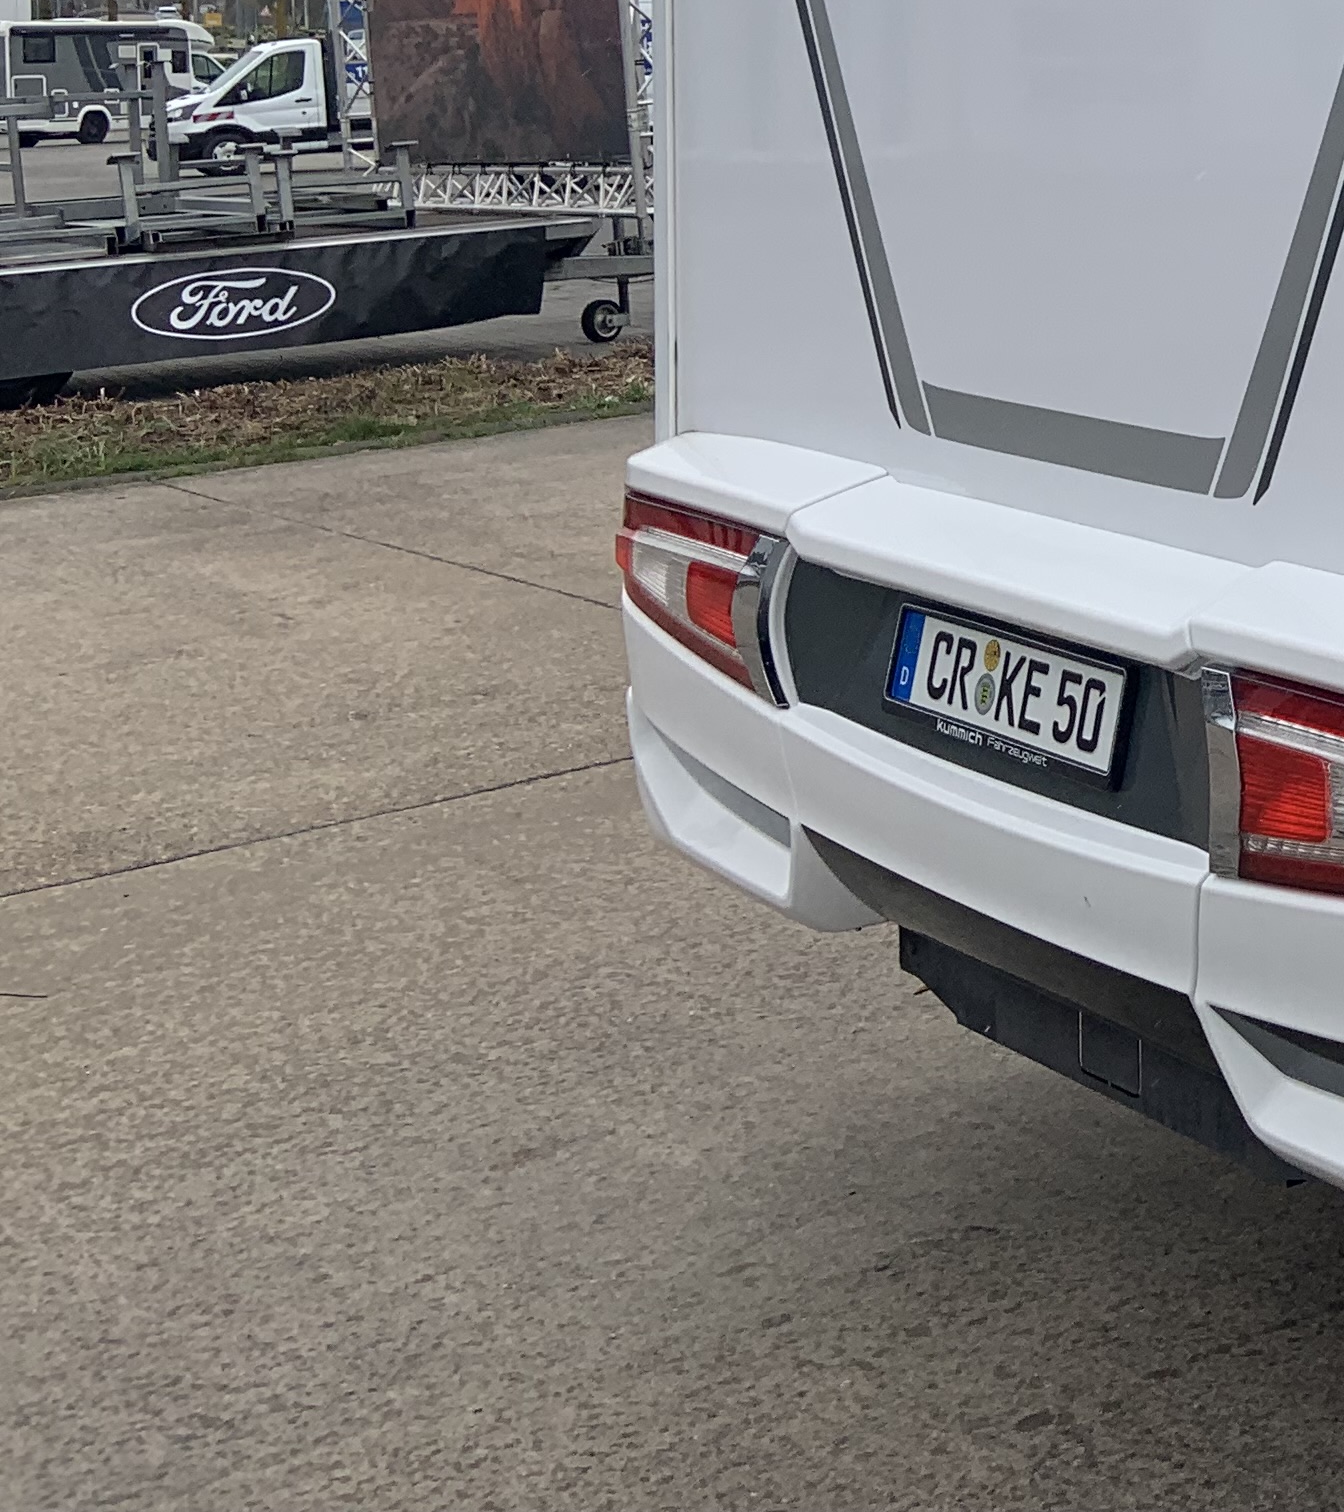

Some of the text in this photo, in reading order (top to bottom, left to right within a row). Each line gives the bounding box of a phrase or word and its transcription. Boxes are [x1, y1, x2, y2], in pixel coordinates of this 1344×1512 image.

[169, 277, 299, 330] Ford
[899, 666, 909, 686] D
[927, 630, 1107, 754] CR KE 50
